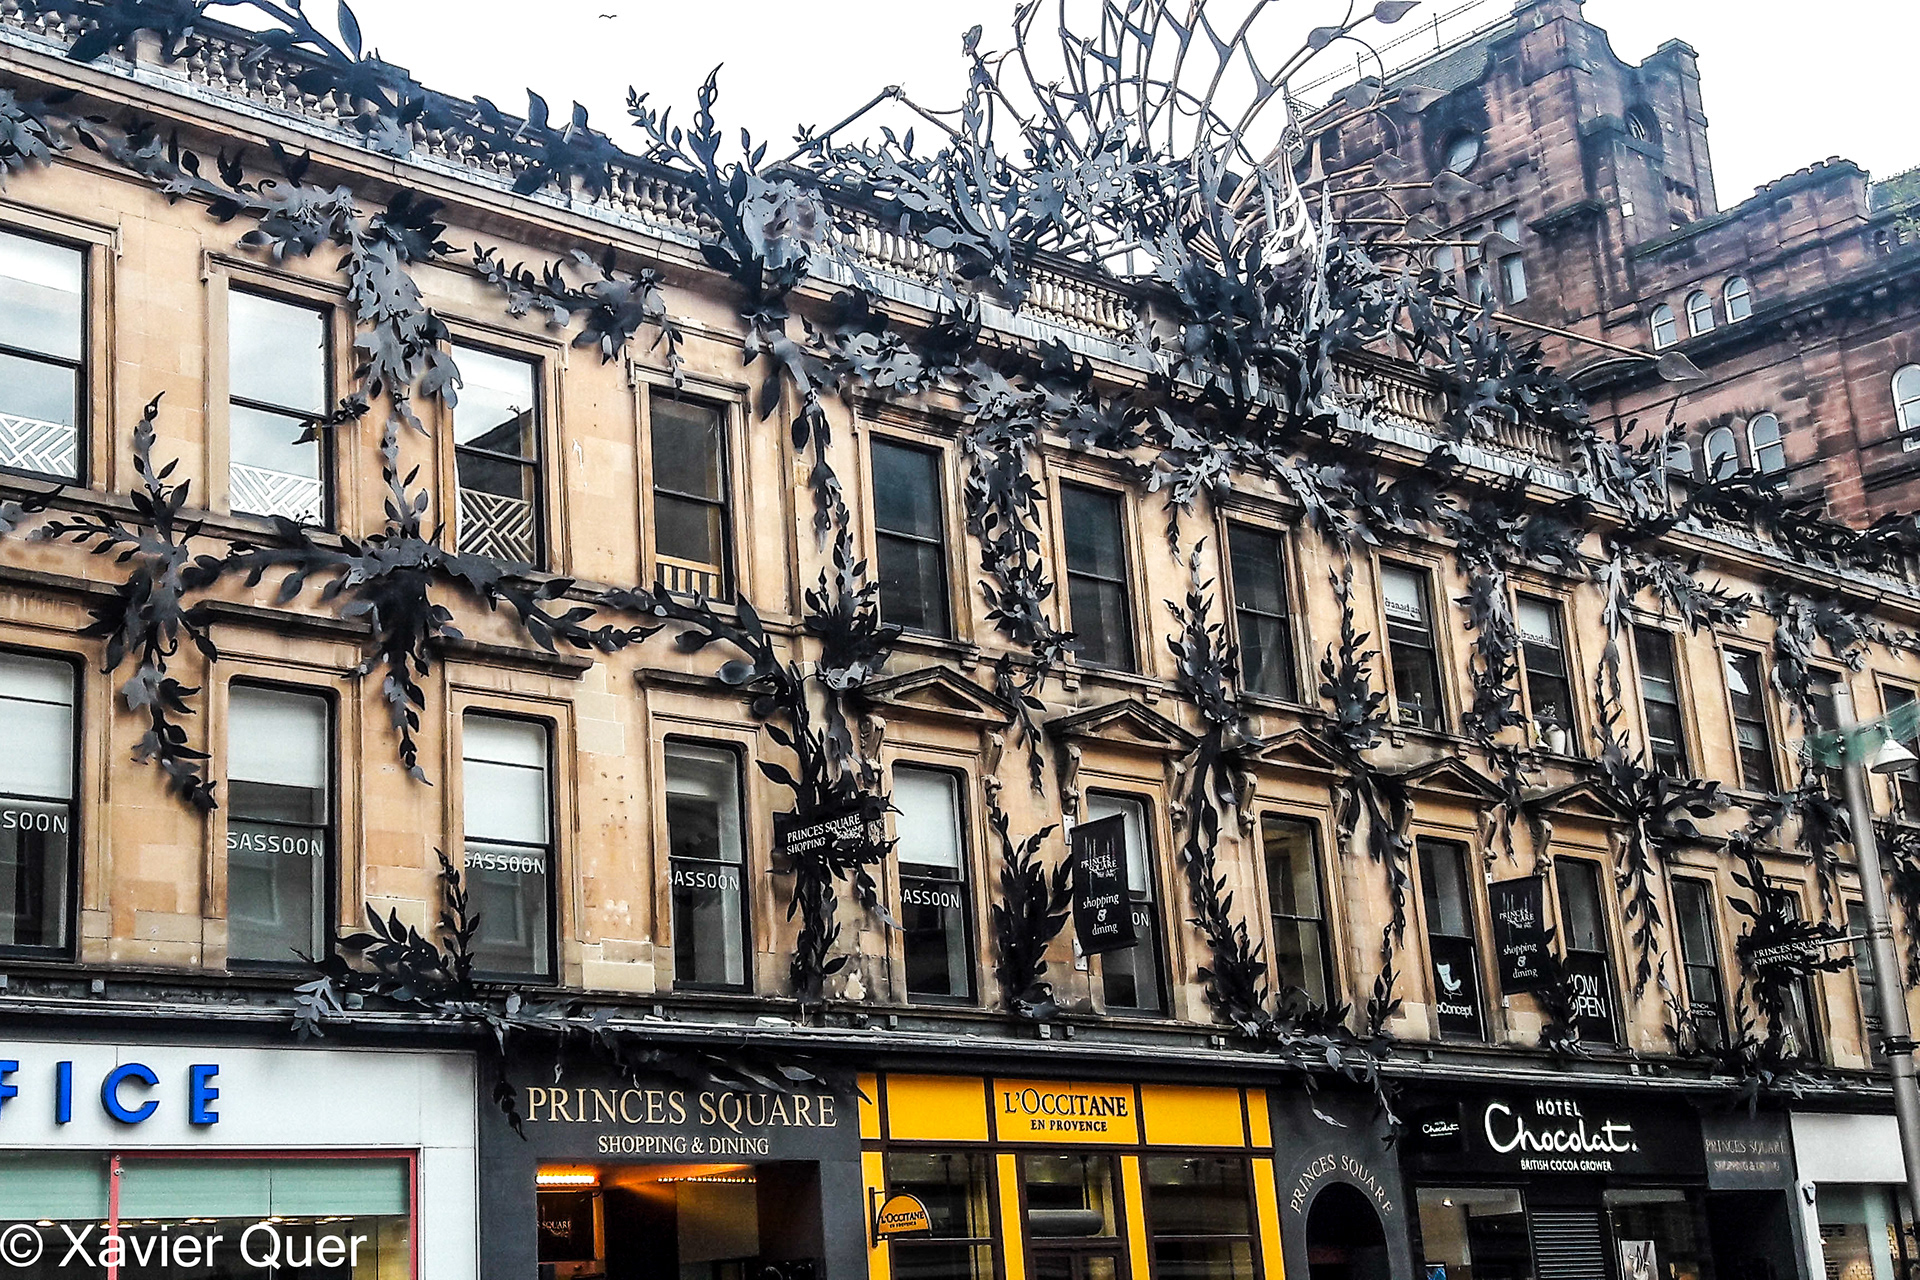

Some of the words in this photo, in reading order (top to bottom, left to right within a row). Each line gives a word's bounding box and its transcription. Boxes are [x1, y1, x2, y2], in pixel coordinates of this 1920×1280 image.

[786, 823, 825, 844] PRINCES
[825, 813, 861, 835] SQUARE
[227, 832, 324, 857] SASSOON
[786, 836, 826, 855] SHOPPING
[464, 851, 545, 875] SASSOON
[900, 888, 960, 909] ASSOON
[1083, 894, 1120, 909] shopping
[1097, 908, 1107, 922] &
[1092, 922, 1119, 936] dining
[1503, 943, 1538, 956] shopping
[1753, 944, 1791, 959] PRINCES
[1517, 956, 1526, 967] &
[1512, 968, 1538, 979] dining
[1571, 974, 1598, 996] OW
[1003, 1087, 1128, 1117] L'OCCITANE
[1536, 1100, 1582, 1117] HOTEL
[525, 1087, 687, 1125] PRINCES
[700, 1090, 837, 1134] SQUARE
[1030, 1119, 1045, 1130] EN
[1049, 1120, 1107, 1132] PROVENCE
[598, 1136, 686, 1154] SHOPPING
[691, 1136, 704, 1154] &
[709, 1137, 769, 1155] DINING
[1706, 1139, 1747, 1153] PRINCES
[1521, 1159, 1549, 1171] BRITISH
[1550, 1160, 1579, 1171] COCOA
[1580, 1160, 1612, 1171] GROWER
[1290, 1153, 1337, 1214] PRINCES
[1341, 1154, 1393, 1215] SQUARE
[880, 1211, 924, 1224] L'OCCITANE
